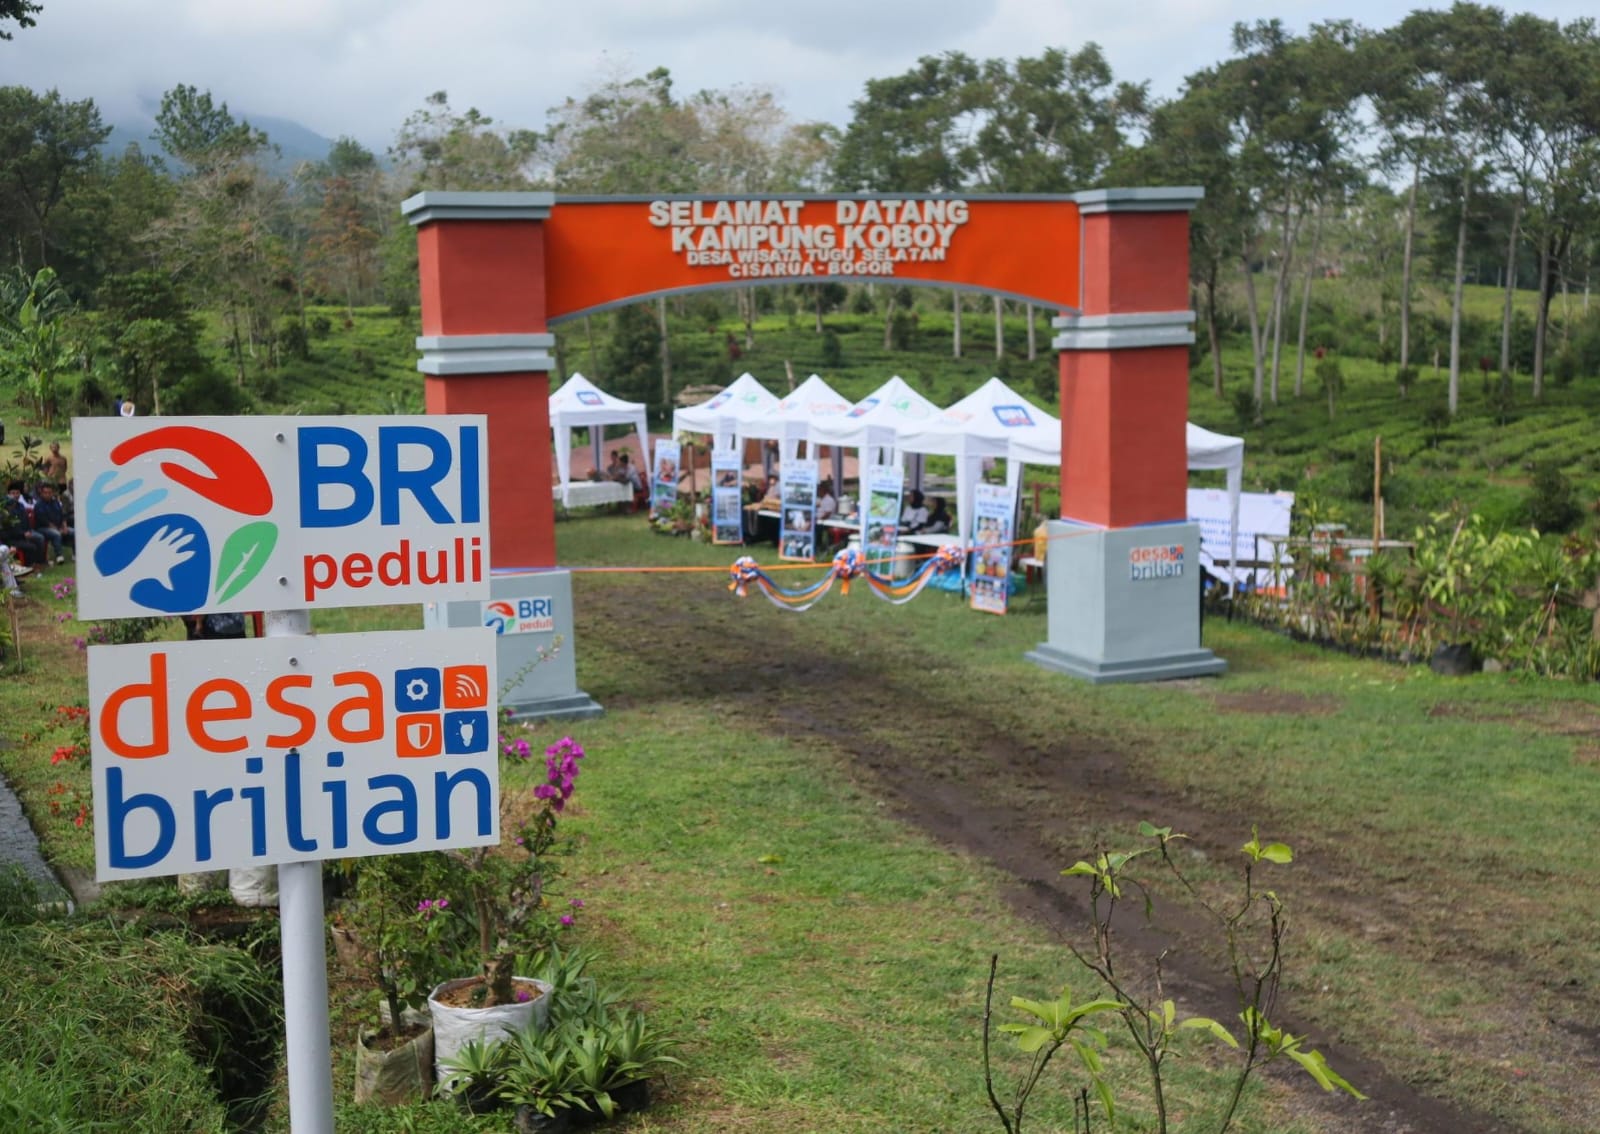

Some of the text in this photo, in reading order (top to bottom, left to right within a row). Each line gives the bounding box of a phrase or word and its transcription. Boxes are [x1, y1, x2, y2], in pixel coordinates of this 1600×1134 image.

[649, 200, 969, 226] SELAMAT DATANG
[671, 223, 957, 252] KAMPUNG KOBOY
[687, 247, 946, 265] DESA WISATA TUGU SELATAN
[728, 261, 815, 277] CISARUA
[827, 261, 894, 275] BOGOR
[297, 425, 481, 528] BRI
[1131, 546, 1169, 562] desa
[304, 538, 482, 601] peduli
[1131, 560, 1184, 581] brilian
[518, 598, 551, 619] BRI
[519, 619, 552, 632] peduli
[100, 653, 385, 759] desa
[106, 751, 493, 869] brilian
